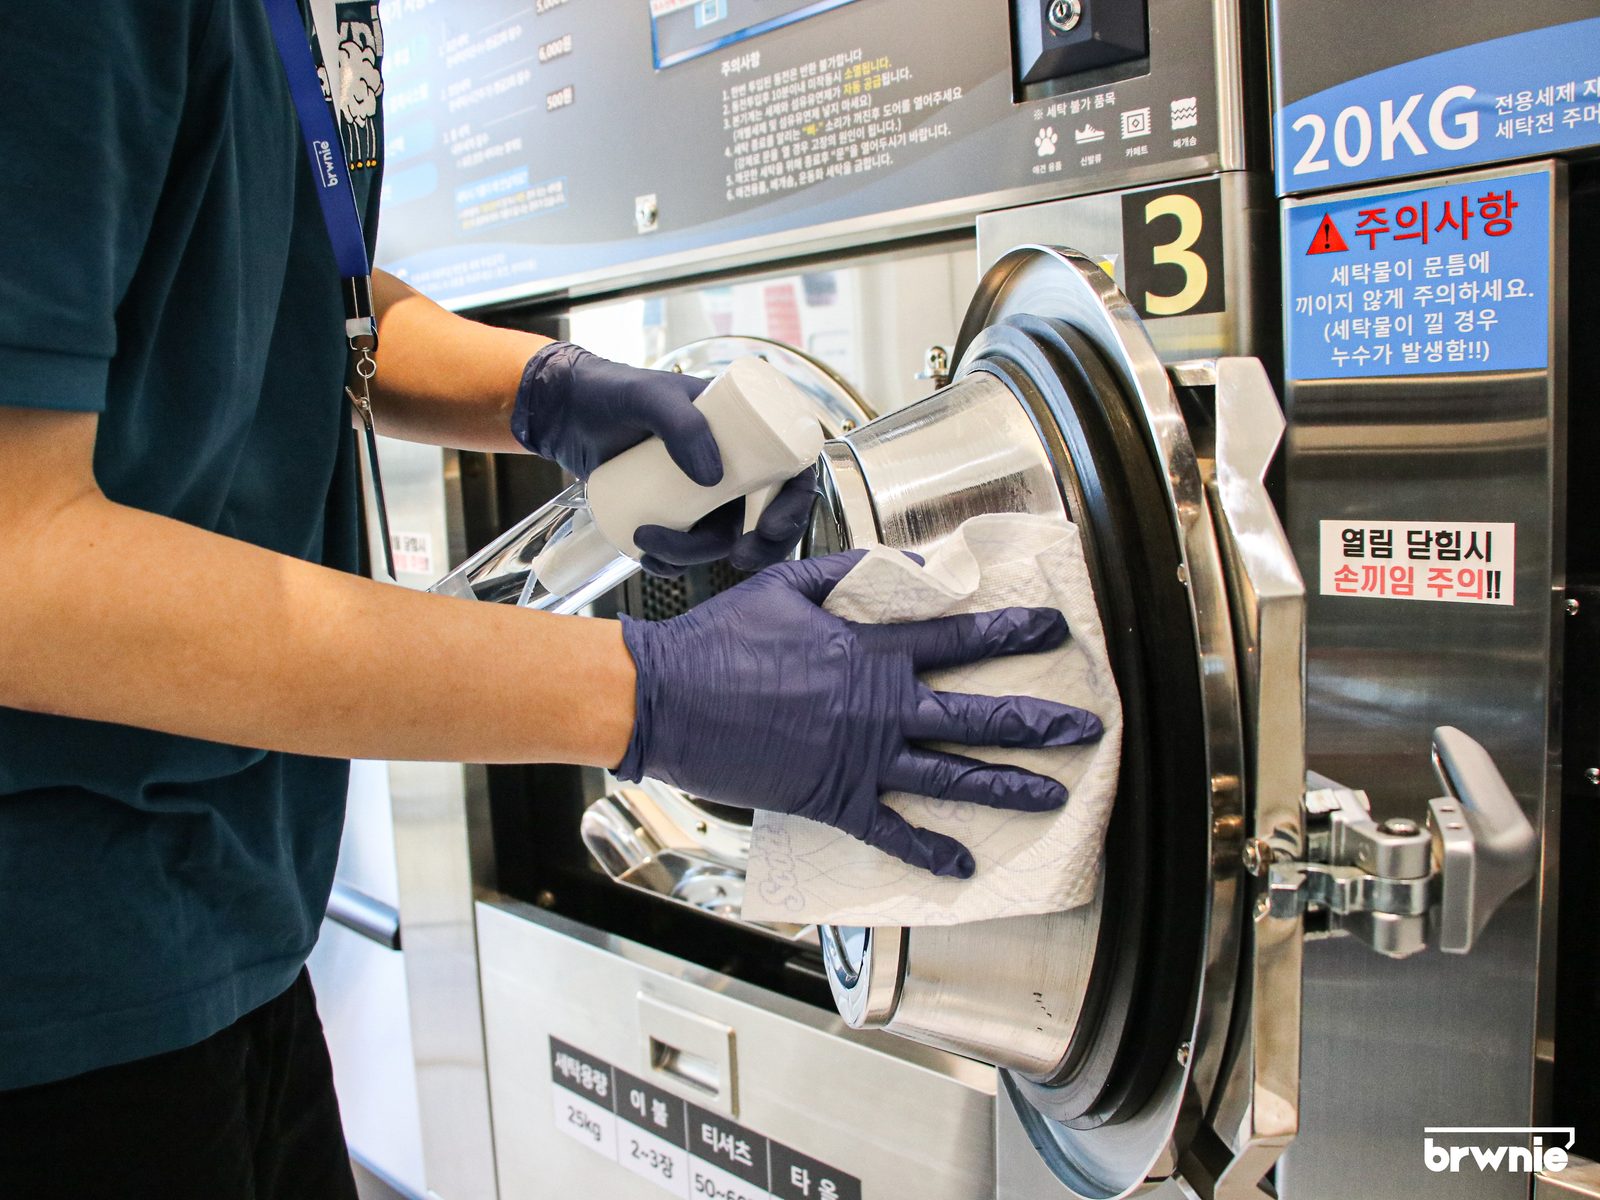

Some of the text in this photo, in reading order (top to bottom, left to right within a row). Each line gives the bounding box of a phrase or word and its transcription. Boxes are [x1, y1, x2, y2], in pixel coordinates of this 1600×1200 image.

[721, 50, 760, 77] 주의사항
[748, 75, 772, 93] 투입된
[773, 67, 798, 86] 동전은
[819, 48, 862, 73] 불가합니다
[772, 80, 806, 101] 10분이내
[844, 56, 892, 80] 소멸됩니다.
[791, 85, 841, 111] 섬유유연제가
[843, 79, 861, 96] 자동
[864, 66, 913, 91] 공급됩니다.
[841, 93, 872, 111] 마세요)
[1046, 104, 1067, 118] 세탁
[1070, 96, 1091, 114] 불가
[1094, 91, 1115, 109] 품목
[1495, 81, 1576, 116] 전용세제
[776, 128, 801, 145] 알리는
[825, 114, 851, 132] 소리가
[853, 106, 880, 124] 꺼진후
[883, 99, 911, 117] 도어를
[913, 86, 962, 111] 열어주세요
[1291, 84, 1480, 176] 20KG
[1495, 112, 1554, 139] 세탁전
[792, 140, 809, 156] 경우
[811, 132, 837, 151] 고장의
[838, 126, 865, 144] 원인이
[868, 118, 902, 138] 됩니다.)
[861, 132, 906, 155] 열어두시기
[908, 122, 952, 144] 바랍니다.
[319, 141, 339, 187] brwnie
[825, 161, 852, 177] 세탁을
[854, 152, 894, 173] 금합니다.
[1080, 153, 1102, 167] 신발류
[1355, 190, 1519, 250] 주의사항
[1145, 194, 1208, 315] 3
[1331, 251, 1490, 287] 세탁물이 문틈에
[1296, 278, 1534, 316] 끼이지 않게 주의하세요.
[1324, 308, 1499, 343] (세탁물이 낄 경우
[1331, 339, 1490, 367] 누수가 발생함!!)
[1341, 528, 1492, 562] 열림 닫힘시
[1334, 564, 1502, 600] 손끼임 주의!!
[555, 1052, 608, 1097] 세탁용량
[568, 1105, 602, 1142] 25kg
[631, 1139, 673, 1179] 2~3장
[701, 1123, 753, 1167] 티셔츠
